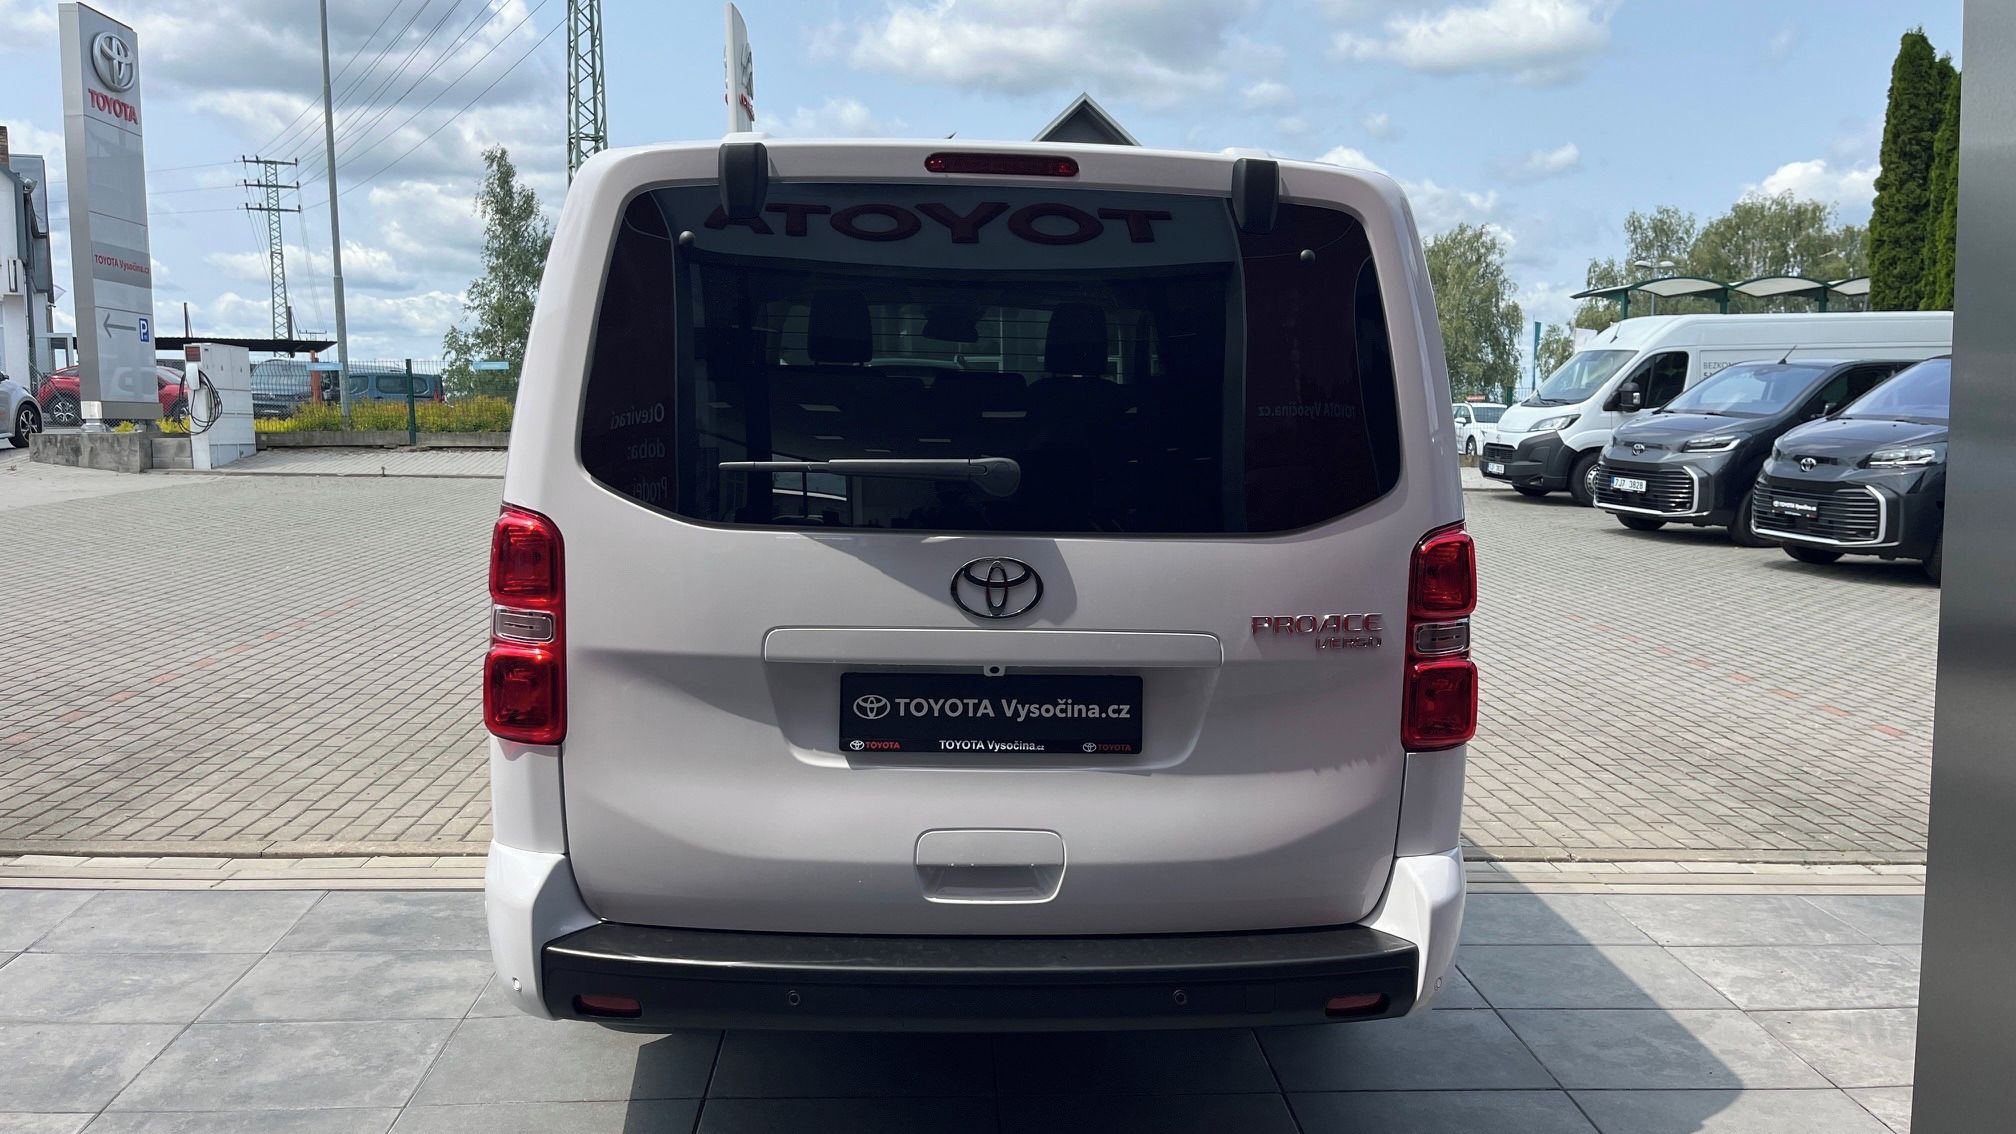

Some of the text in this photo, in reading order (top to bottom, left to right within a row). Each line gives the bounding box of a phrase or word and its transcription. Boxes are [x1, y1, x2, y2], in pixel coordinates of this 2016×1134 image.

[88, 88, 138, 125] TOYOTA
[94, 254, 119, 268] TOYOTA
[1251, 612, 1383, 634] PROACE
[1315, 636, 1383, 650] VERSO
[895, 698, 1131, 722] TOYOTA Vysočina.cz
[865, 741, 901, 750] TOYOTA
[939, 740, 1045, 752] TOYOTA Vysočina.cz
[1097, 743, 1132, 752] TOYOTA
